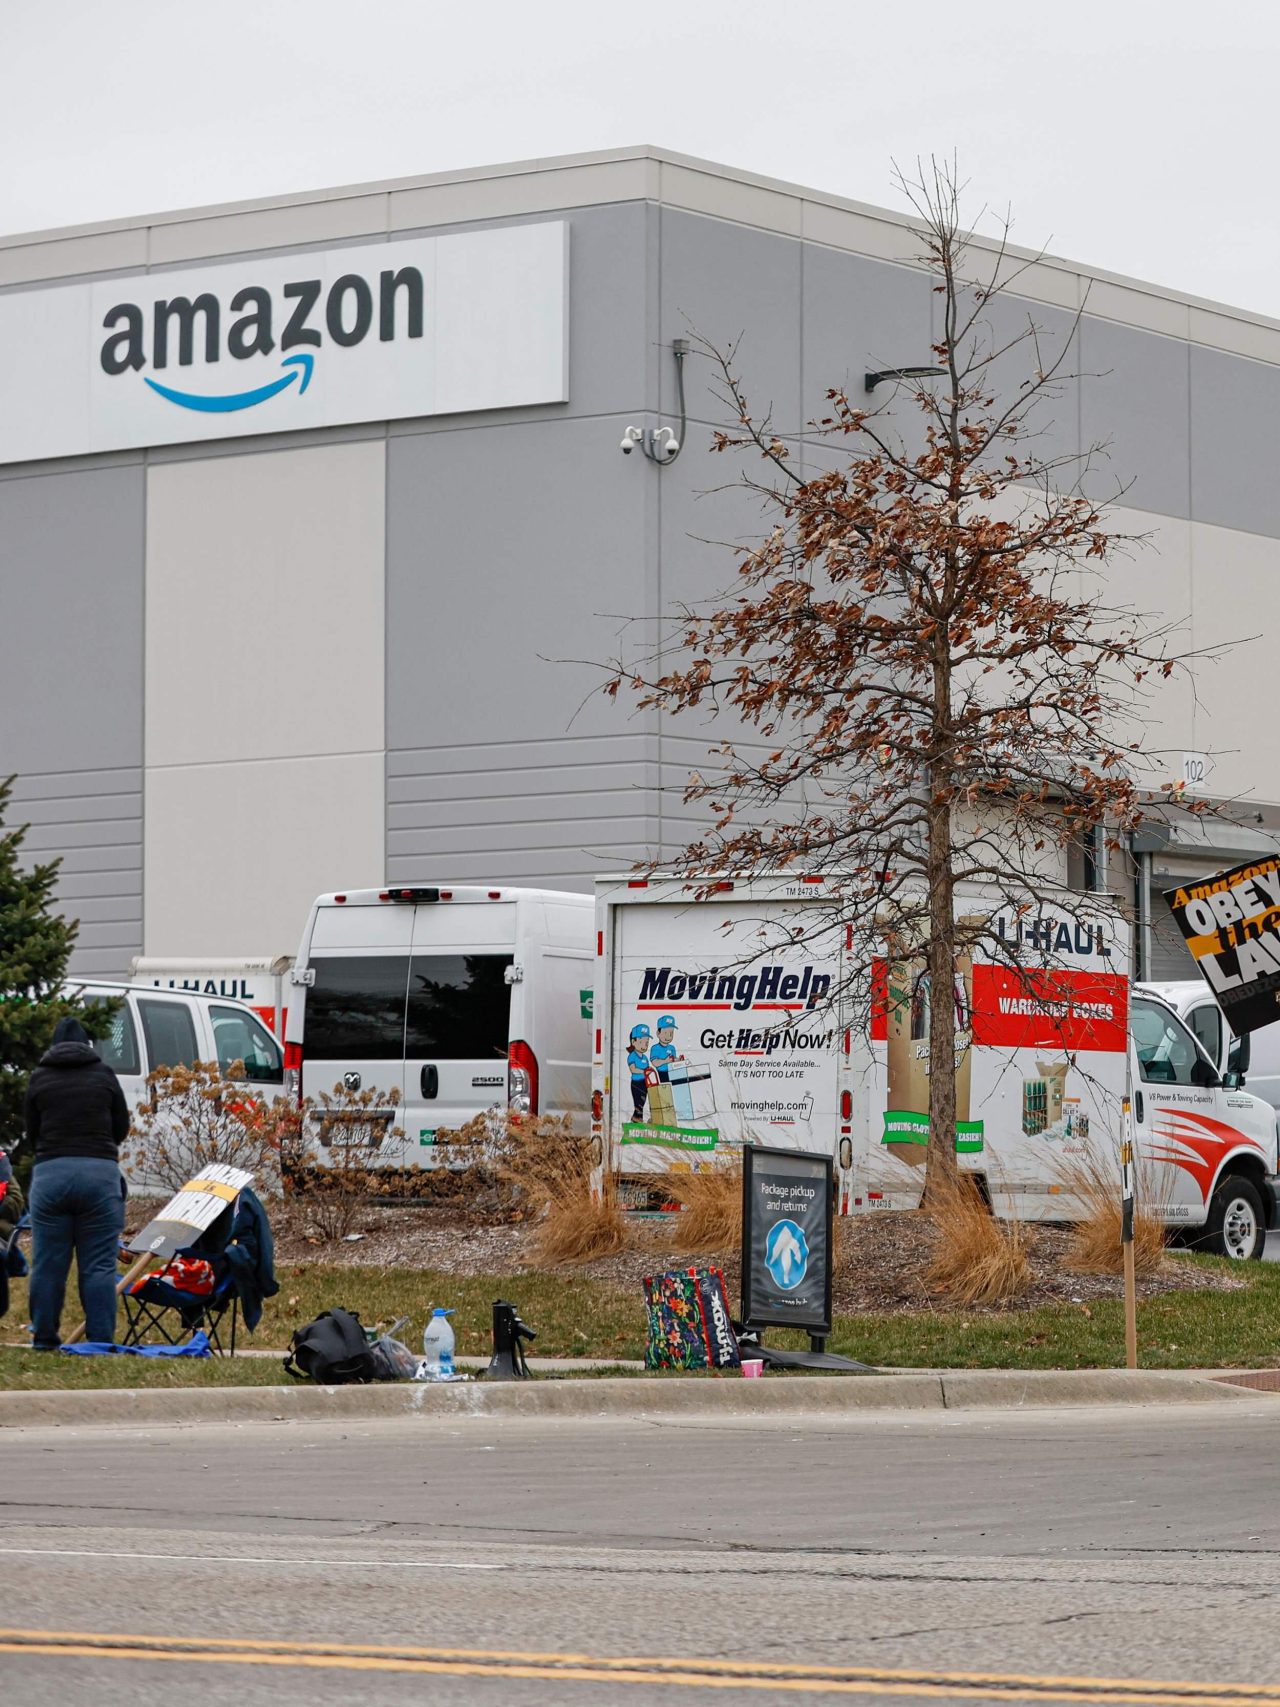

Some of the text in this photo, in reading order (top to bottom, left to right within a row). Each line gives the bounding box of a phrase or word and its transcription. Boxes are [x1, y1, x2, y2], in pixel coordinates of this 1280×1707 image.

[100, 266, 424, 376] amazon
[1185, 760, 1203, 781] 102
[786, 887, 796, 896] TM
[797, 887, 813, 896] 2473
[999, 917, 1112, 957] U-HAUL
[700, 1028, 834, 1055] Get Help Now!
[718, 1060, 738, 1068] Same
[740, 1060, 753, 1068] Day
[755, 1060, 781, 1068] Service
[731, 1100, 807, 1111] movinghelp.com
[1156, 1093, 1171, 1101] Power
[1177, 1093, 1193, 1104] Towing
[1193, 1094, 1213, 1105] Capacity
[761, 1183, 815, 1199] Package pickup
[766, 1200, 807, 1212] and returns
